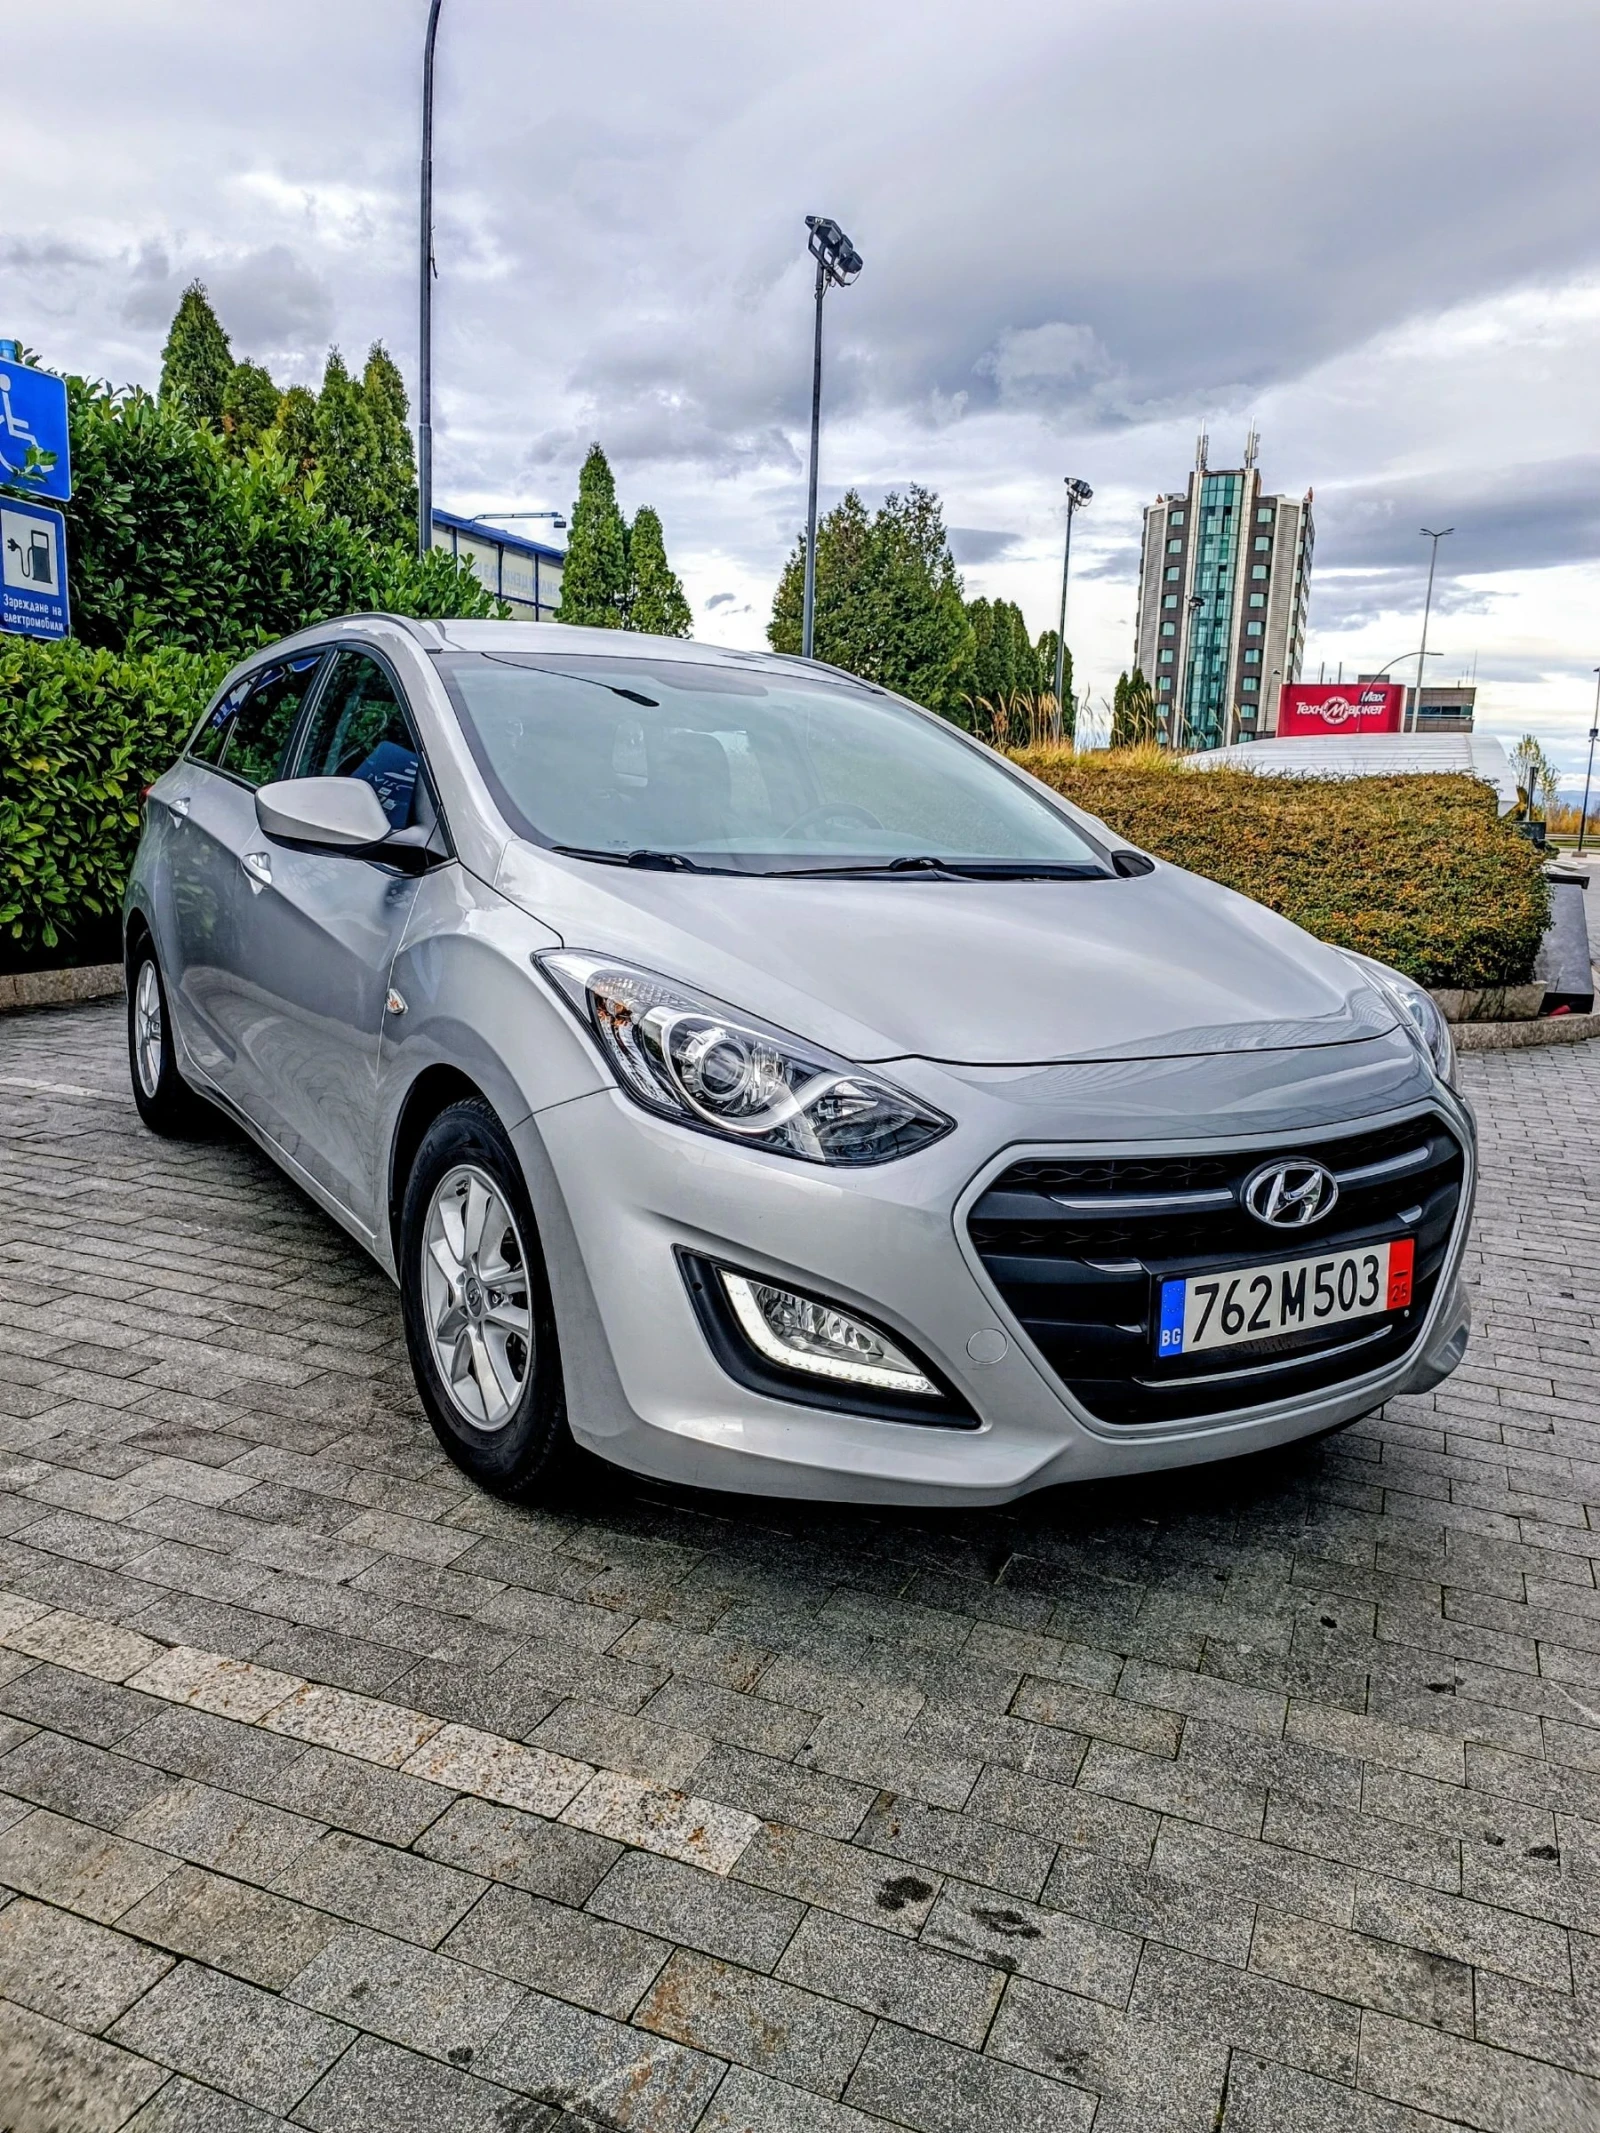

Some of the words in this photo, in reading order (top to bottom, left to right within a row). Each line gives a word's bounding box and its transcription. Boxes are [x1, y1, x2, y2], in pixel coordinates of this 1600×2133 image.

[3, 593, 49, 614] Зареждане
[52, 606, 62, 617] на
[3, 612, 64, 632] електромобили
[1192, 1254, 1380, 1343] 762M503
[1392, 1283, 1408, 1302] 25
[1161, 1328, 1182, 1347] BG
